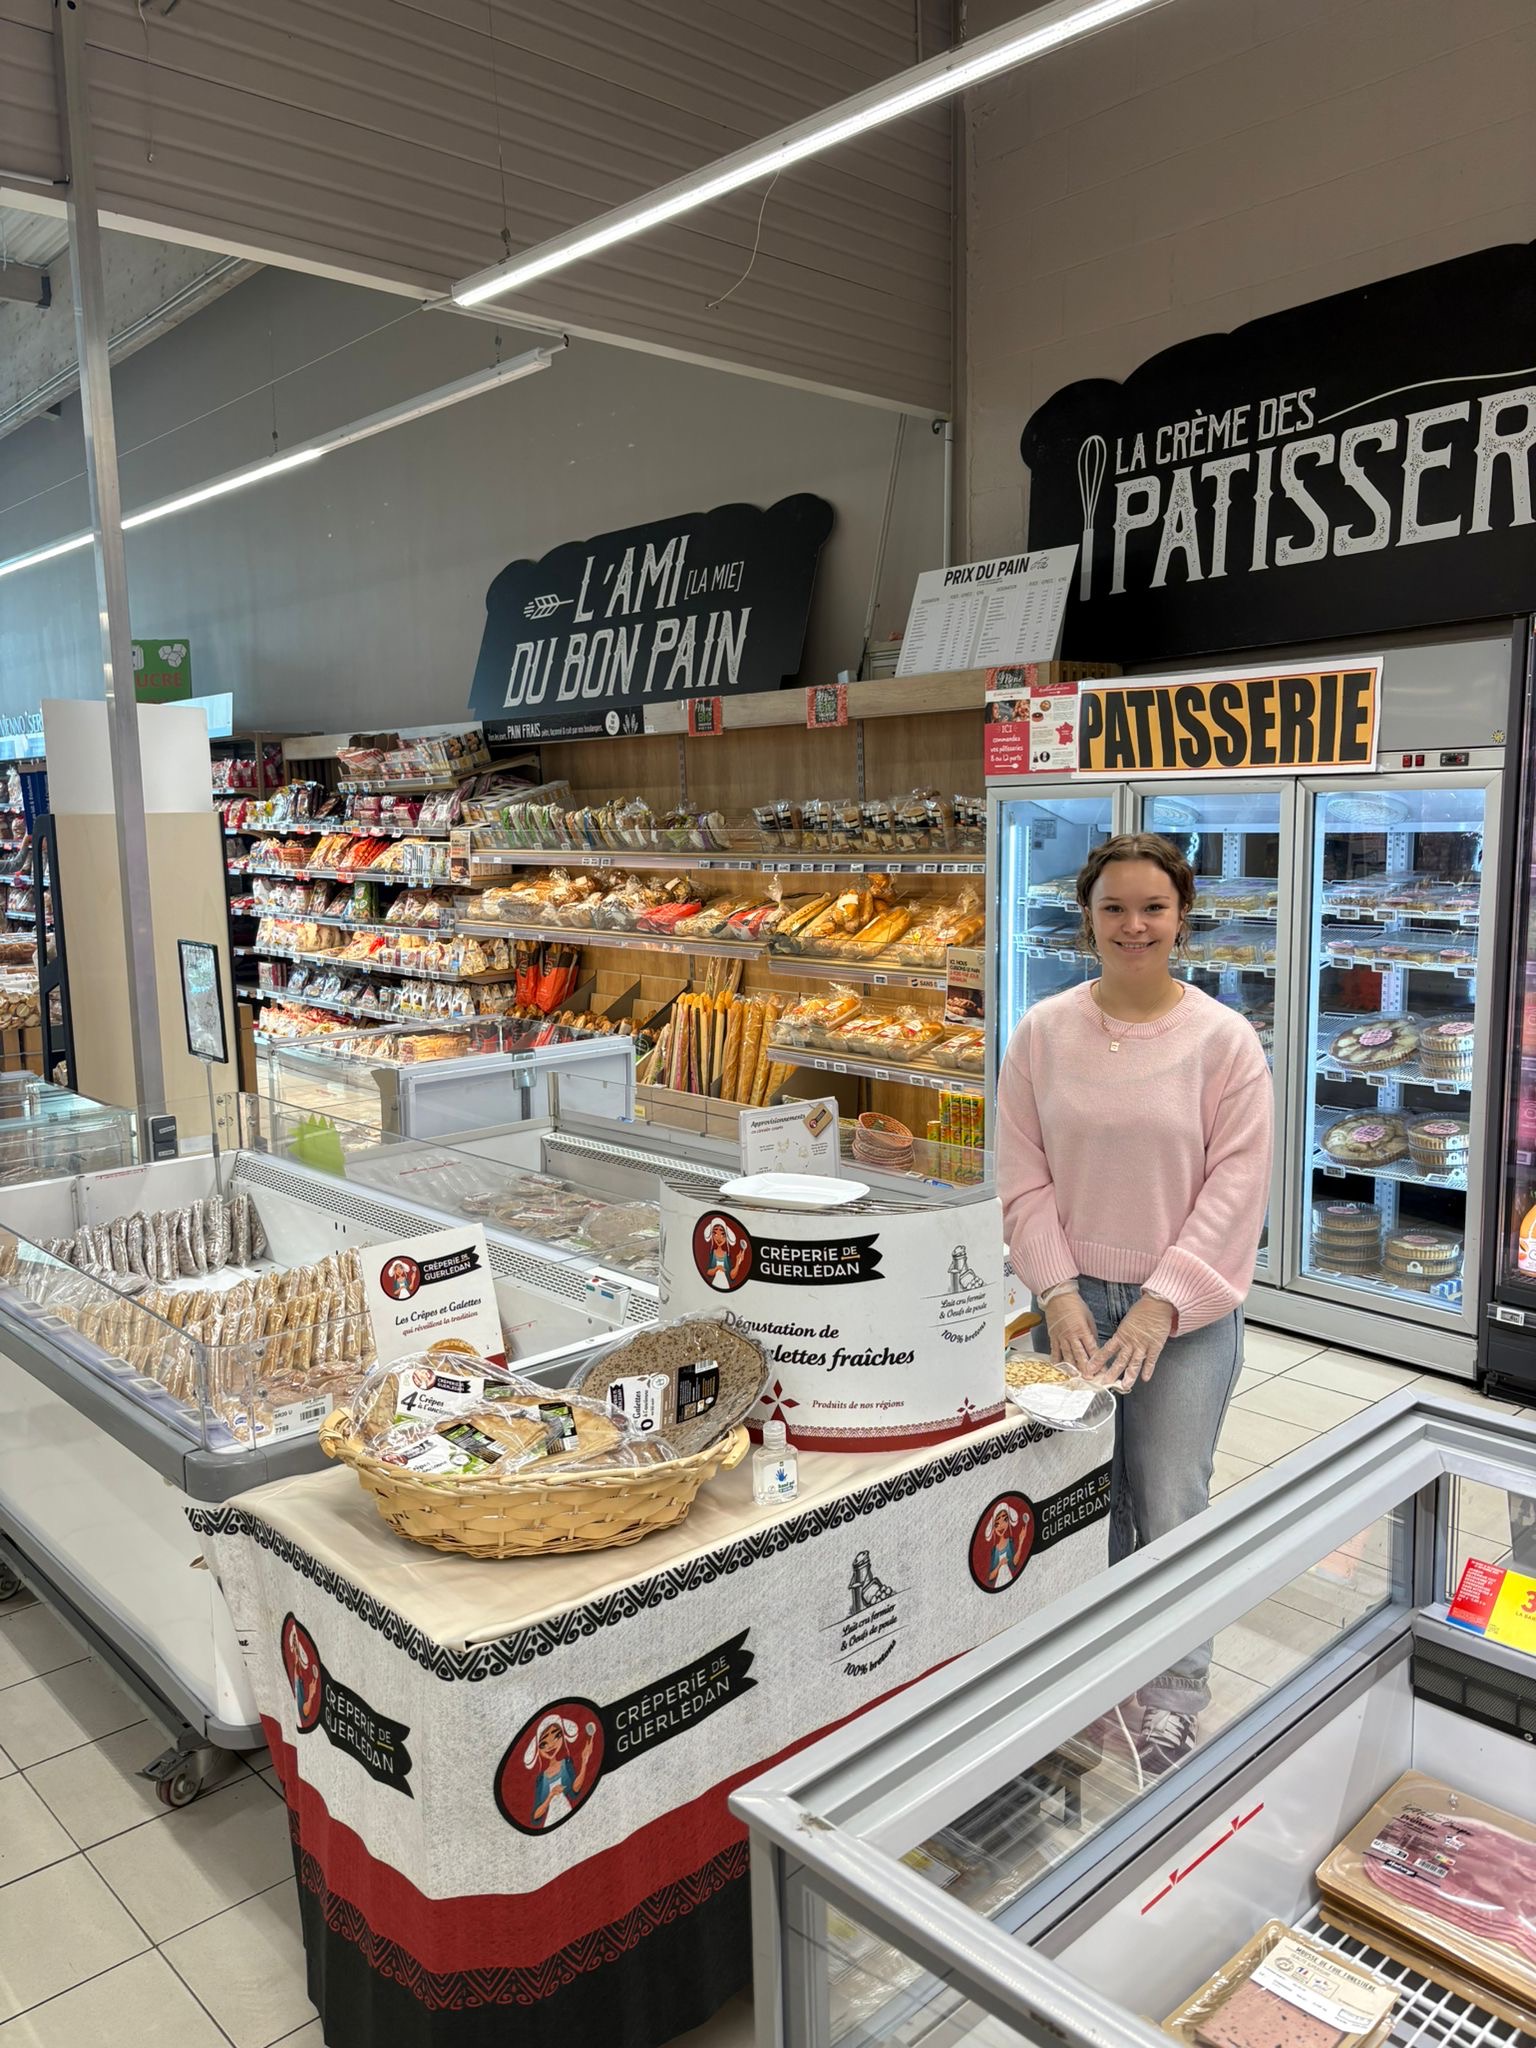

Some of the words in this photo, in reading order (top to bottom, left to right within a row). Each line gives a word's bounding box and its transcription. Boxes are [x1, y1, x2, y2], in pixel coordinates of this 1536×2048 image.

[1115, 432, 1147, 475] LA
[1156, 409, 1250, 465] CRÈME
[1257, 388, 1316, 441] DES
[573, 535, 690, 623] L'AMI
[944, 567, 975, 587] PRIX
[975, 563, 995, 581] DU
[997, 557, 1030, 577] PAIN
[503, 637, 558, 708] DU
[556, 624, 643, 701] BON
[643, 607, 752, 692] PAIN
[135, 672, 183, 688] UCRE
[1001, 725, 1012, 733] ICI
[1079, 672, 1371, 769] PATISSERIE
[507, 724, 521, 739] PAIN
[522, 723, 540, 738] FRAIS
[992, 735, 1020, 743] commandez
[842, 1246, 858, 1256] DE
[760, 1262, 860, 1279] GUERLÉDAN
[395, 1316, 408, 1325] Les
[410, 1309, 438, 1322] Crêpes
[440, 1306, 448, 1314] et
[449, 1298, 482, 1312] Galettes
[402, 1327, 413, 1336] qui
[415, 1320, 442, 1332] réveillent
[451, 1311, 478, 1322] tradition
[724, 1310, 817, 1339] Dégustation
[819, 1324, 839, 1339] de
[941, 1330, 963, 1343] 100%
[827, 1347, 914, 1372] fraîches
[401, 1391, 418, 1411] 4
[419, 1394, 444, 1407] Crêpes
[812, 1400, 847, 1409] Produits
[848, 1400, 858, 1409] de
[875, 1399, 905, 1411] régions
[1098, 1473, 1110, 1487] DE
[1521, 1590, 1536, 1613] 3
[840, 1641, 848, 1651] &
[869, 1625, 878, 1635] de
[711, 1656, 728, 1674] DE
[843, 1662, 868, 1676] 100%
[617, 1676, 730, 1753] GUERLÉDAN
[378, 1728, 392, 1744] DE
